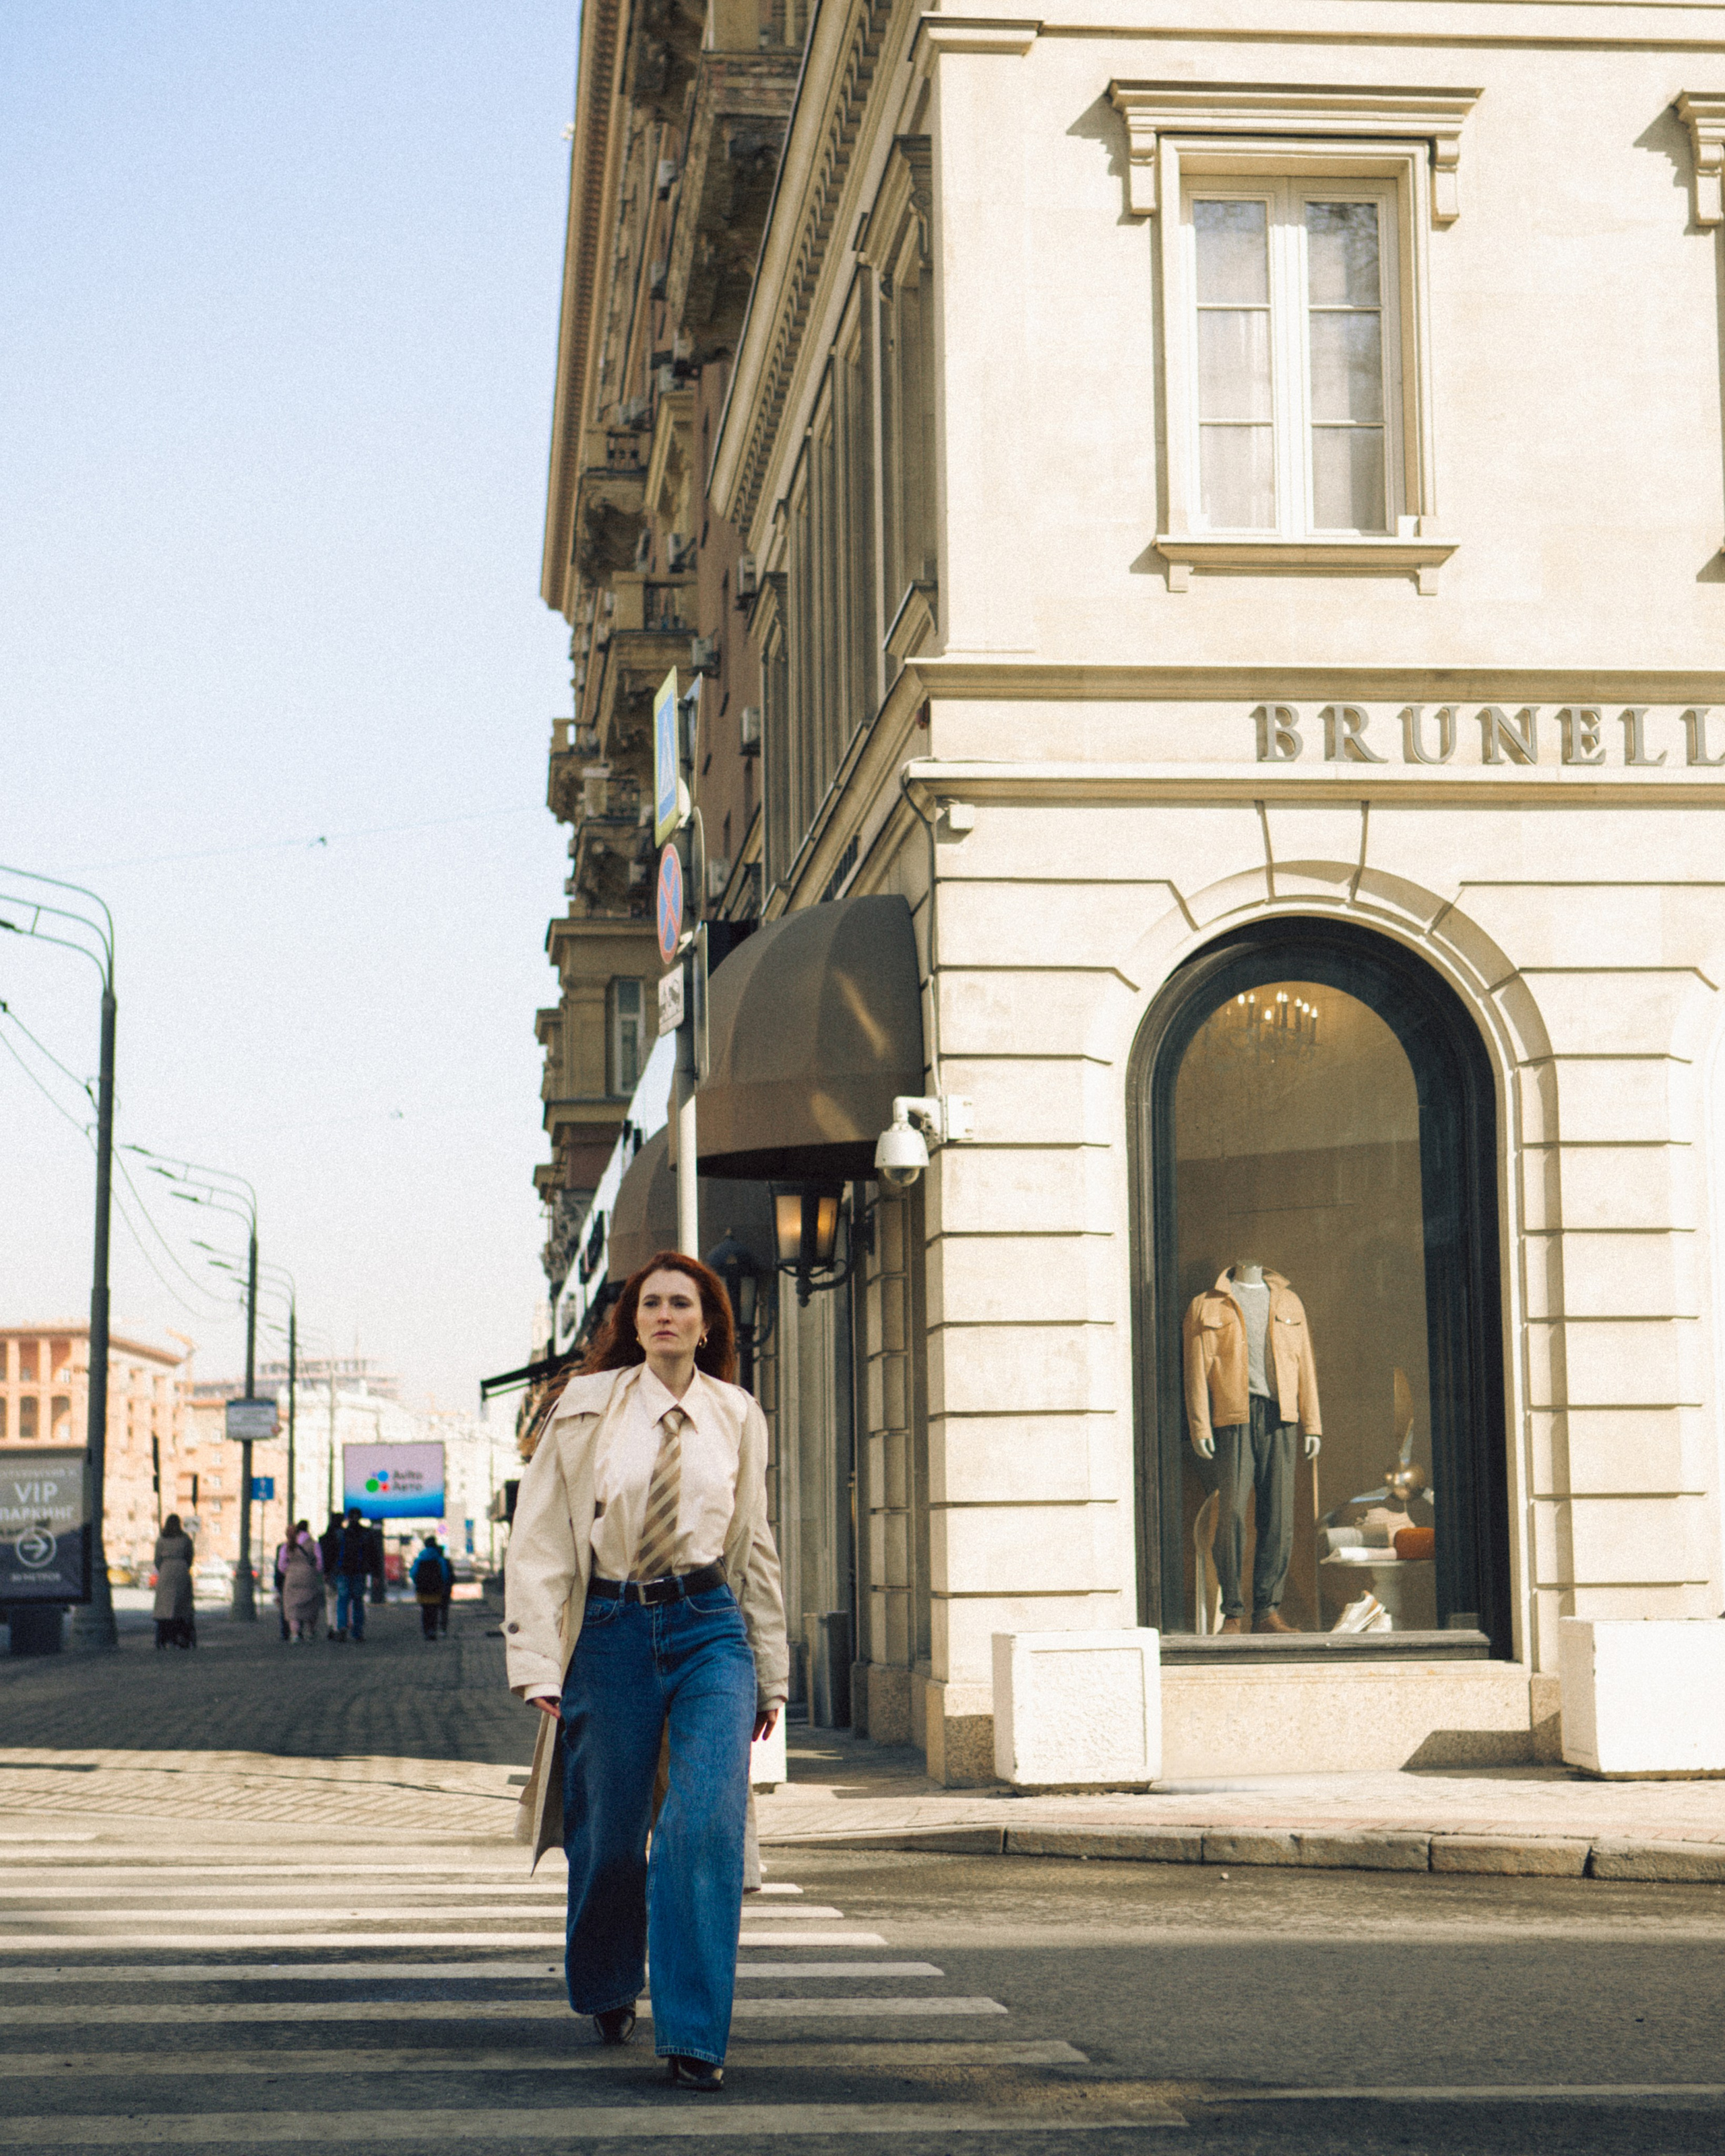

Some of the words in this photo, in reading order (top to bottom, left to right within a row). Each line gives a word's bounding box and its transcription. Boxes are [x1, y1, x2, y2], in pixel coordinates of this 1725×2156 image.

[1250, 703, 1725, 766] BRUNELL
[14, 1481, 58, 1504] VIP
[0, 1505, 73, 1520] ПАРКИНГ
